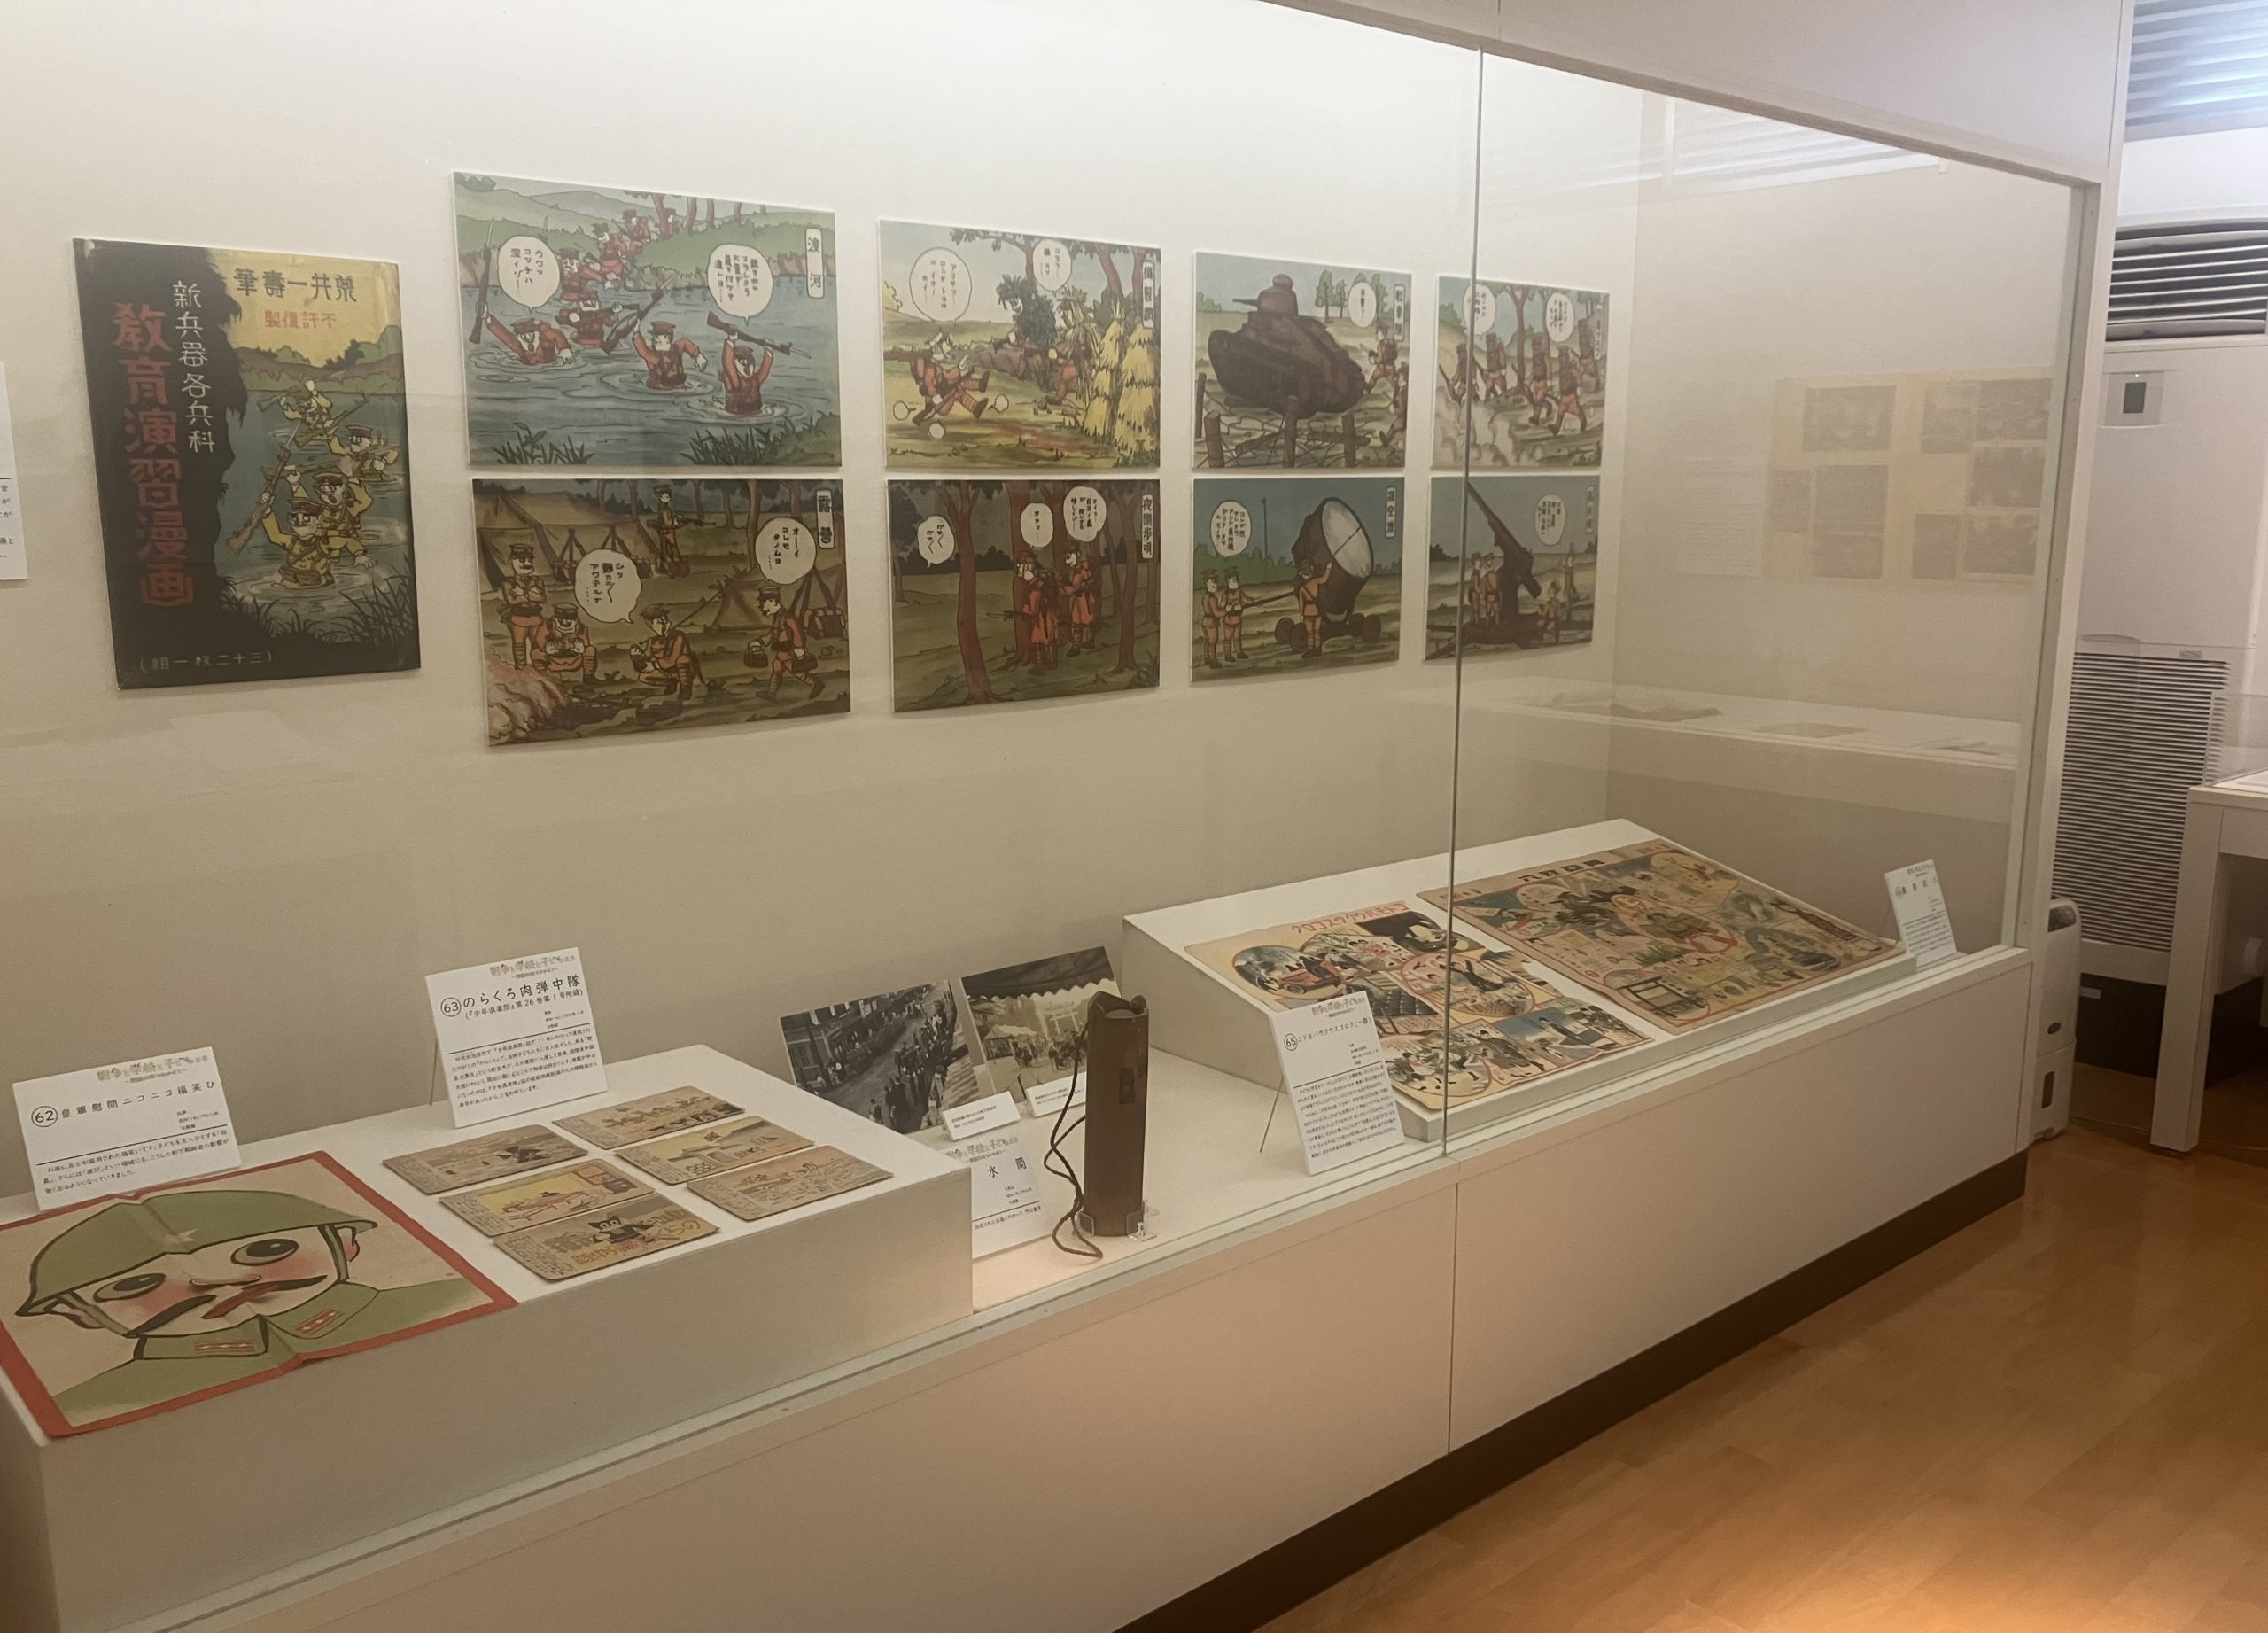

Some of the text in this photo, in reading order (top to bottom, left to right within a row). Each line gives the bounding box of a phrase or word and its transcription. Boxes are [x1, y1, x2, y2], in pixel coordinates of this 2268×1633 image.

[173, 280, 215, 453] 新兵器各兵科
[463, 975, 581, 1007] のらくろ肉弾中隊
[443, 1001, 459, 1015] 63
[34, 1109, 56, 1124] 62
